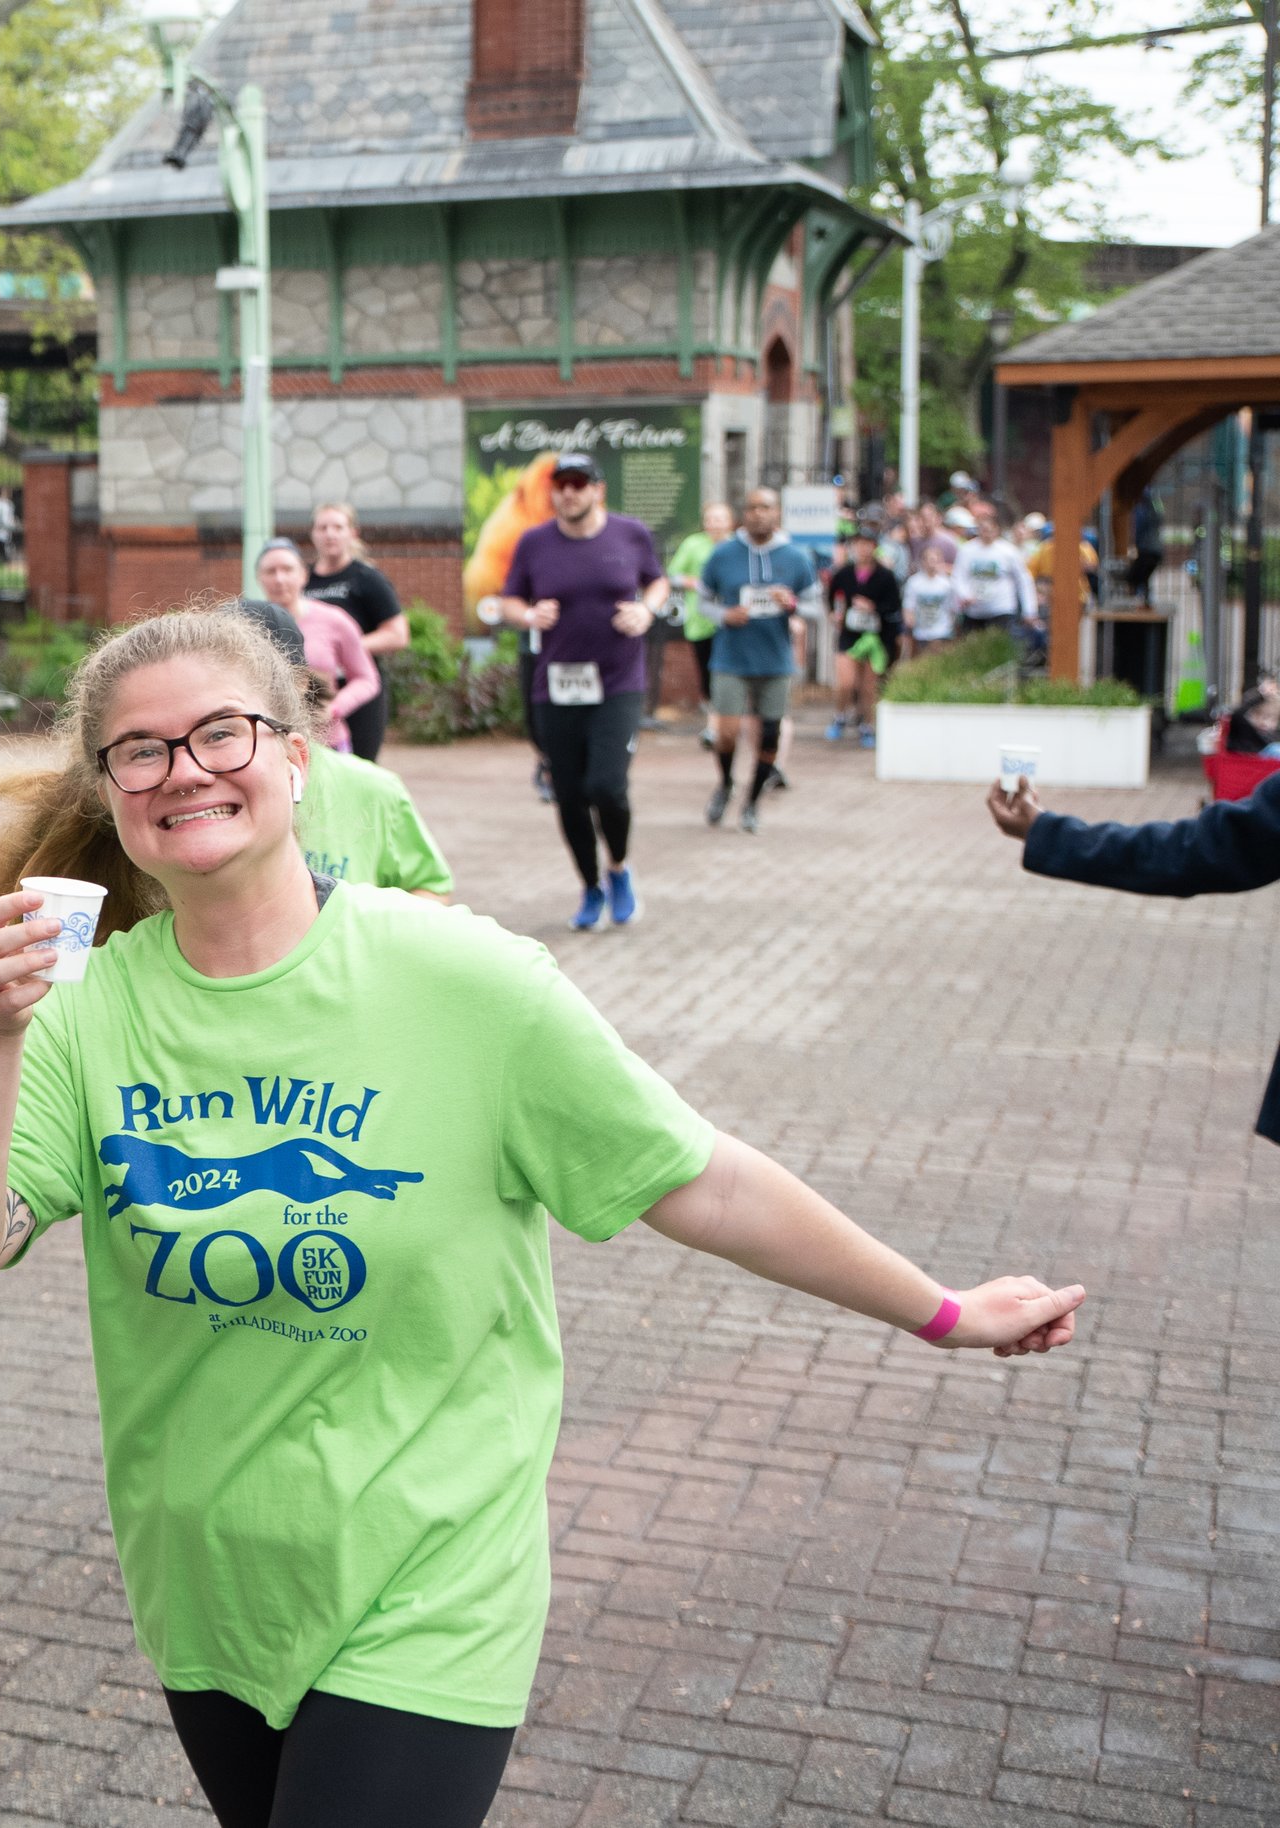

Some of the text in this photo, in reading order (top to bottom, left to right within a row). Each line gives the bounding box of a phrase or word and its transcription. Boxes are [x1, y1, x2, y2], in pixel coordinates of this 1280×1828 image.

[599, 418, 687, 449] Future
[117, 1076, 381, 1142] Run Wild
[168, 1169, 241, 1201] 2024
[283, 1206, 348, 1225] for the
[130, 1222, 366, 1313] ZOO
[302, 1248, 340, 1269] 5K
[303, 1270, 342, 1286] FUN
[306, 1285, 343, 1300] RUN
[209, 1313, 221, 1322] at
[211, 1315, 367, 1343] PHILADELPHIA ZOO
